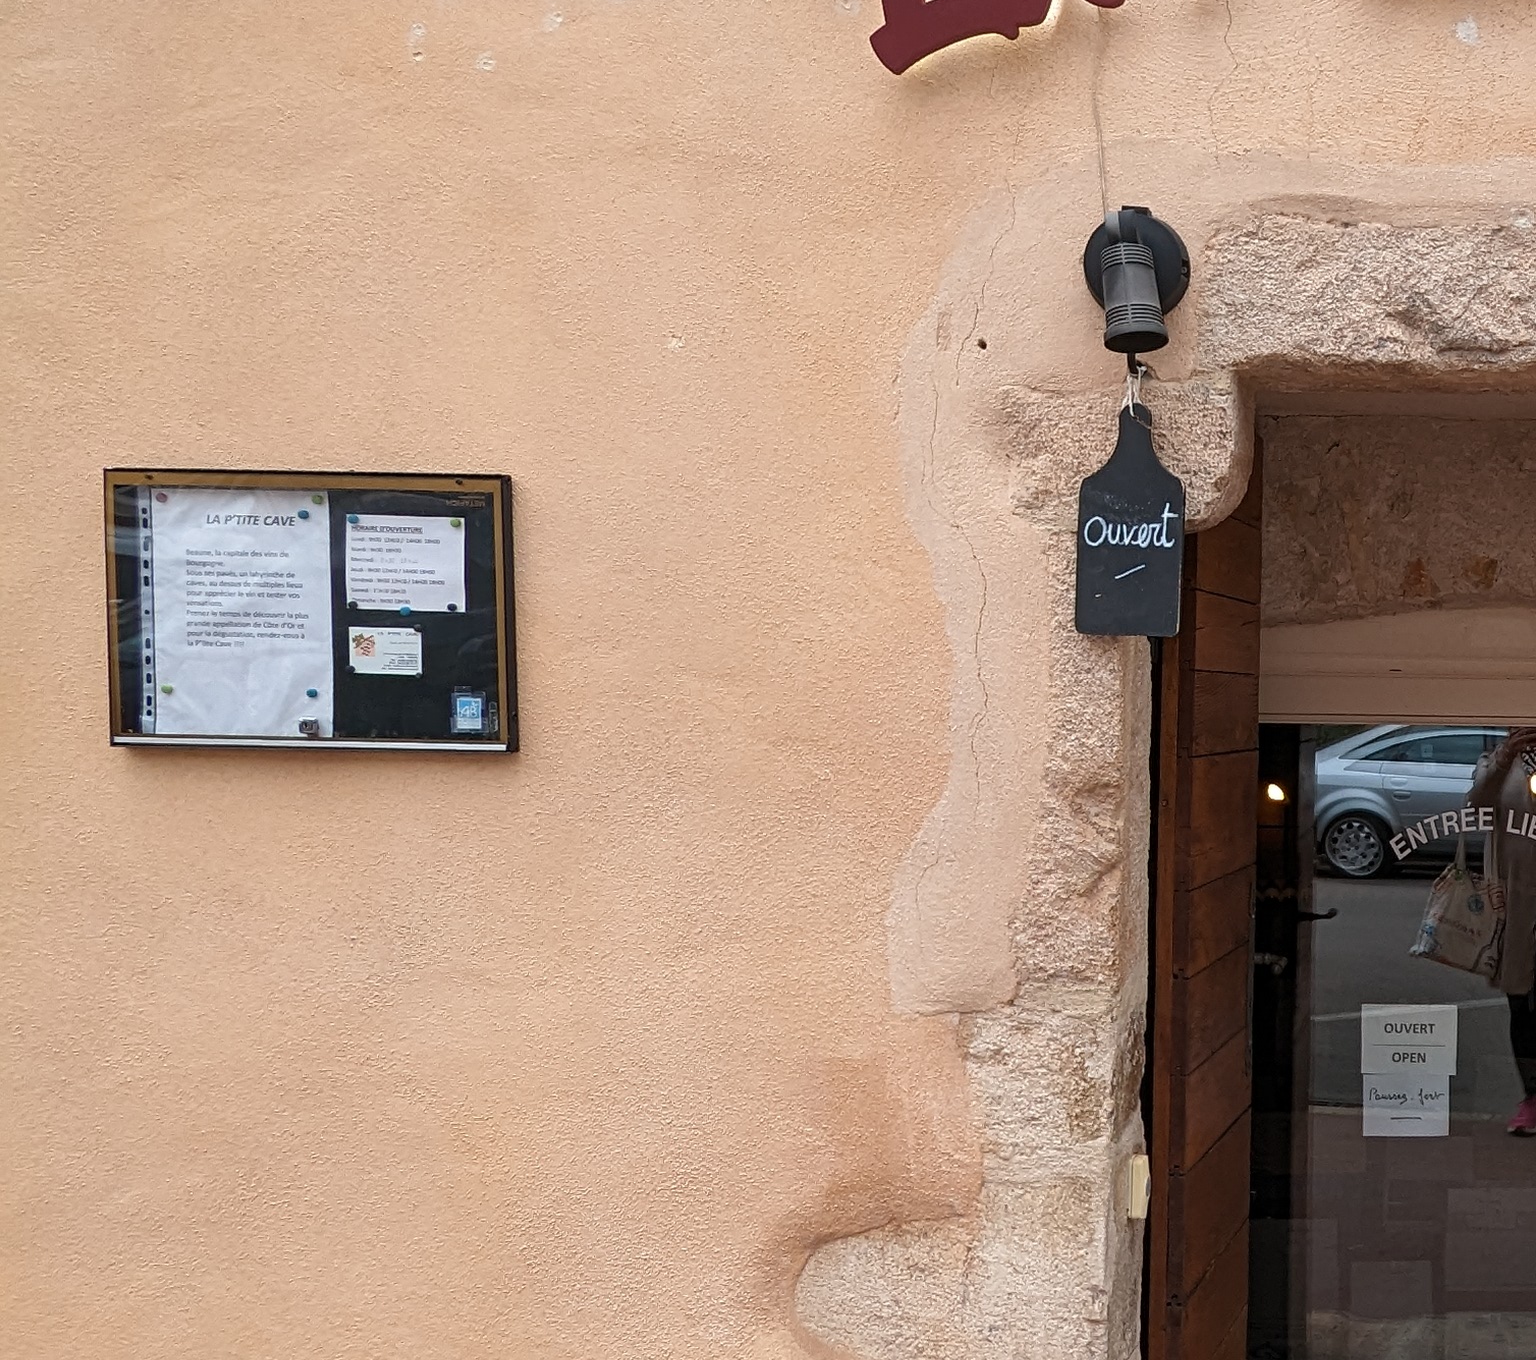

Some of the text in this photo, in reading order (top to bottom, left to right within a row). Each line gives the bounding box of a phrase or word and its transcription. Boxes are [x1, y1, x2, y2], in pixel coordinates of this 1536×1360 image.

[206, 514, 221, 525] LA
[263, 515, 296, 527] CAVE
[1083, 503, 1179, 549] Ouvert
[1389, 802, 1494, 861] ENTRÉE
[1384, 1023, 1435, 1034] OUVERT
[1391, 1052, 1426, 1063] OPEN
